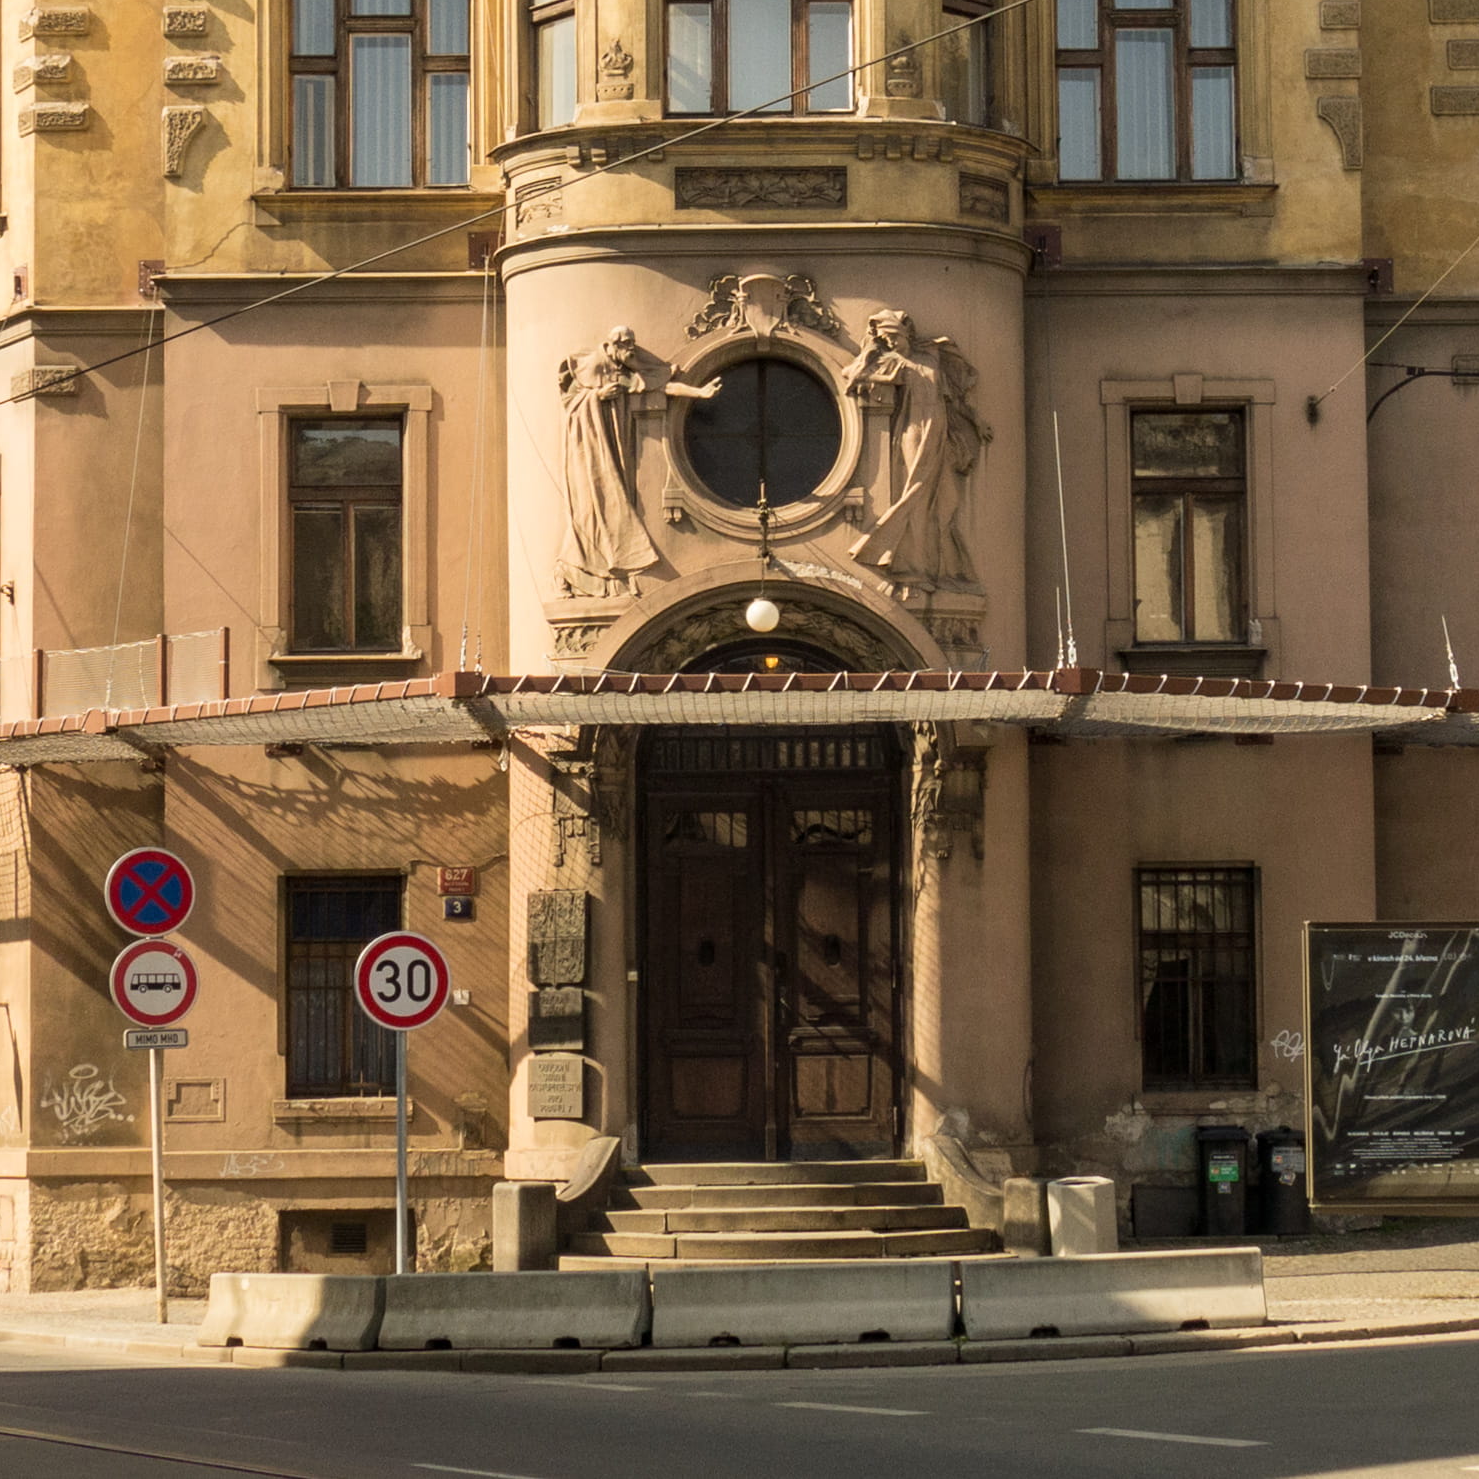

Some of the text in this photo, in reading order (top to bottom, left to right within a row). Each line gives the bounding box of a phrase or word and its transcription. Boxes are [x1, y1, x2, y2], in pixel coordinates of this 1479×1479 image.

[445, 868, 468, 881] 627
[453, 901, 462, 913] 3
[376, 959, 431, 1003] 30
[136, 1033, 178, 1044] MIMO MHD
